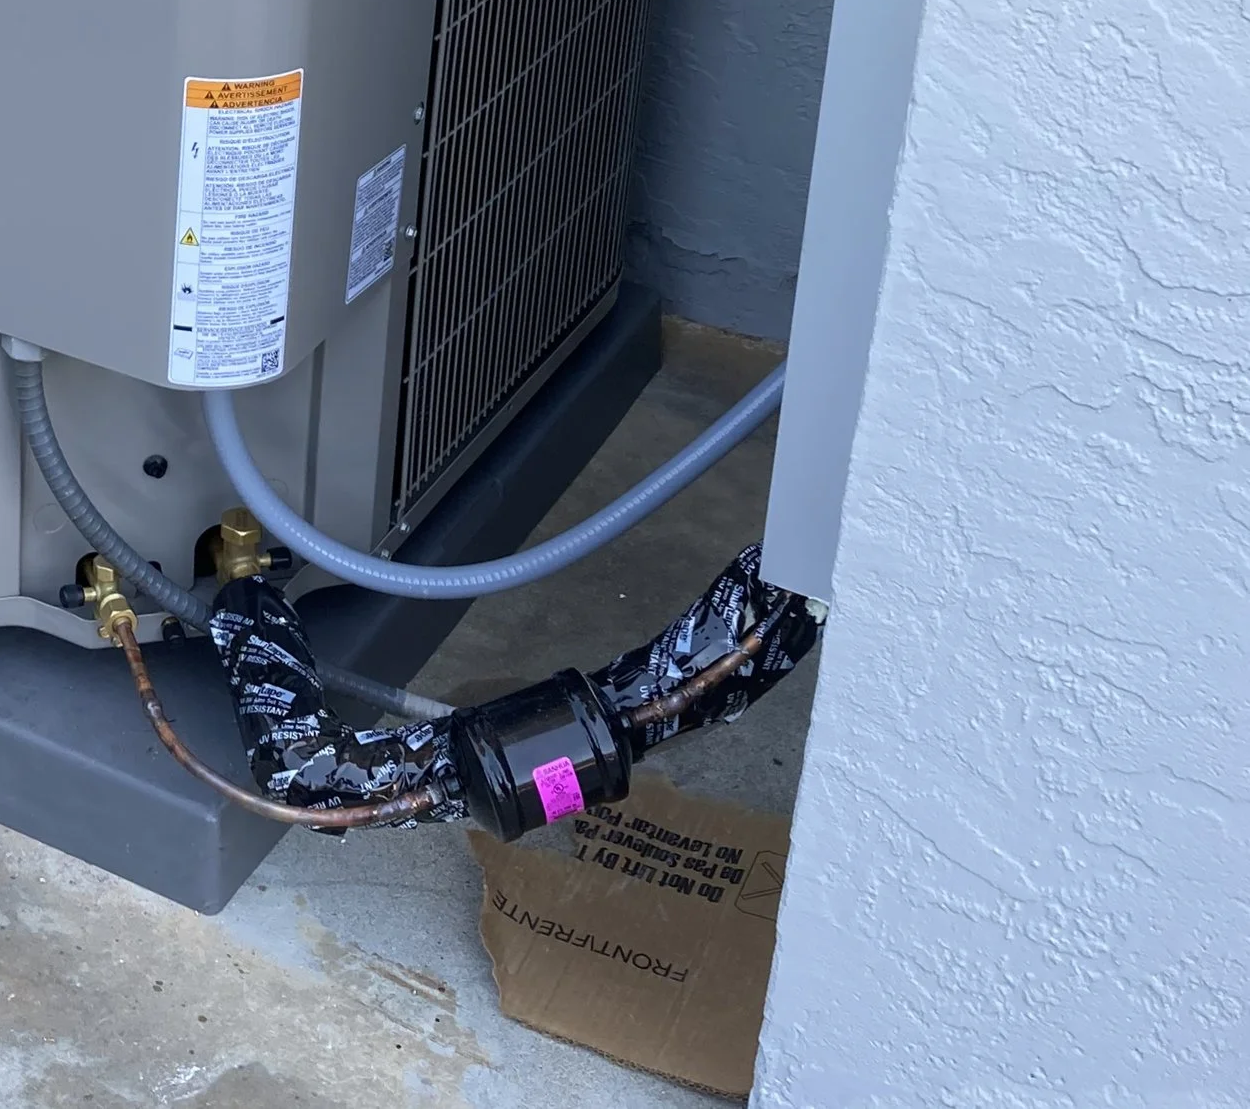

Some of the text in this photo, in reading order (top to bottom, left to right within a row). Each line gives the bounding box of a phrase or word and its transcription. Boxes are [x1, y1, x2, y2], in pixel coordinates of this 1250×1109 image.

[217, 85, 288, 100] AVERTISSEMENT
[234, 80, 275, 90] WARNING
[223, 96, 283, 108] ADVERTENCIA
[625, 817, 713, 857] Levantar
[592, 847, 620, 870] By
[601, 829, 682, 869] Soulever
[715, 846, 744, 865] No
[620, 857, 657, 884] Lift
[683, 856, 718, 880] Pas
[719, 866, 746, 885] De
[658, 870, 696, 896] Not
[697, 882, 726, 903] Do
